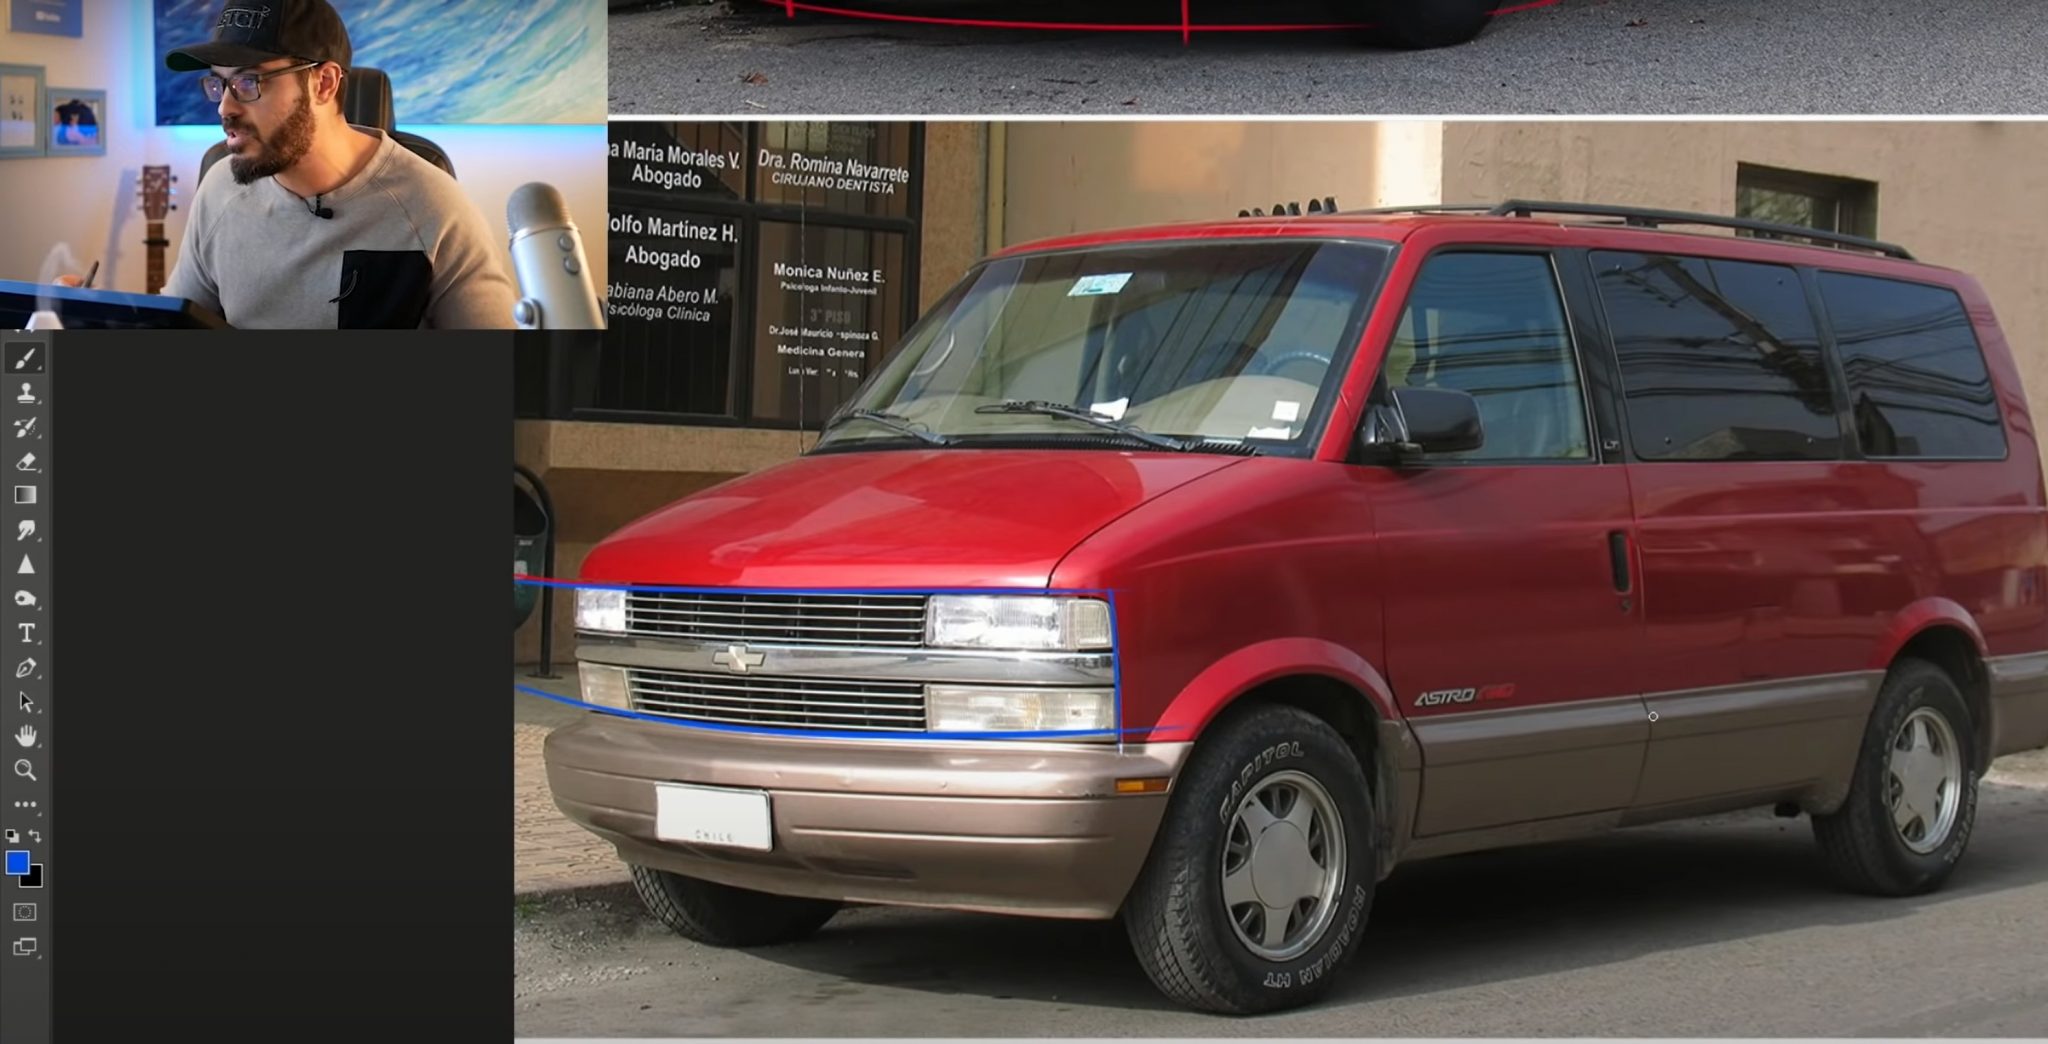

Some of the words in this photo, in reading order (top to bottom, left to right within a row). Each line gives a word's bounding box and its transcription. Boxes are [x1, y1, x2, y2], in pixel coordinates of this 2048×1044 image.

[623, 140, 664, 162] María
[667, 145, 725, 169] Morales
[728, 151, 740, 170] V.
[759, 148, 786, 169] Dra.
[790, 152, 843, 175] Romina
[846, 158, 910, 184] Navarrete
[632, 163, 702, 190] Abogado
[772, 172, 834, 189] CIRUJANO
[836, 178, 895, 195] DENTISTA
[648, 216, 718, 241] Martínez
[722, 223, 738, 243] H.
[625, 245, 701, 271] Abogado
[774, 262, 823, 278] Monica
[827, 266, 870, 282] Nuñez
[872, 269, 886, 284] E.
[656, 285, 700, 304] Abero
[703, 287, 719, 304] M.
[608, 302, 663, 321] sicóloga
[825, 309, 852, 325] PISO
[777, 344, 825, 357] Medicina
[18, 622, 36, 643] T
[1413, 687, 1476, 706] ASTRO
